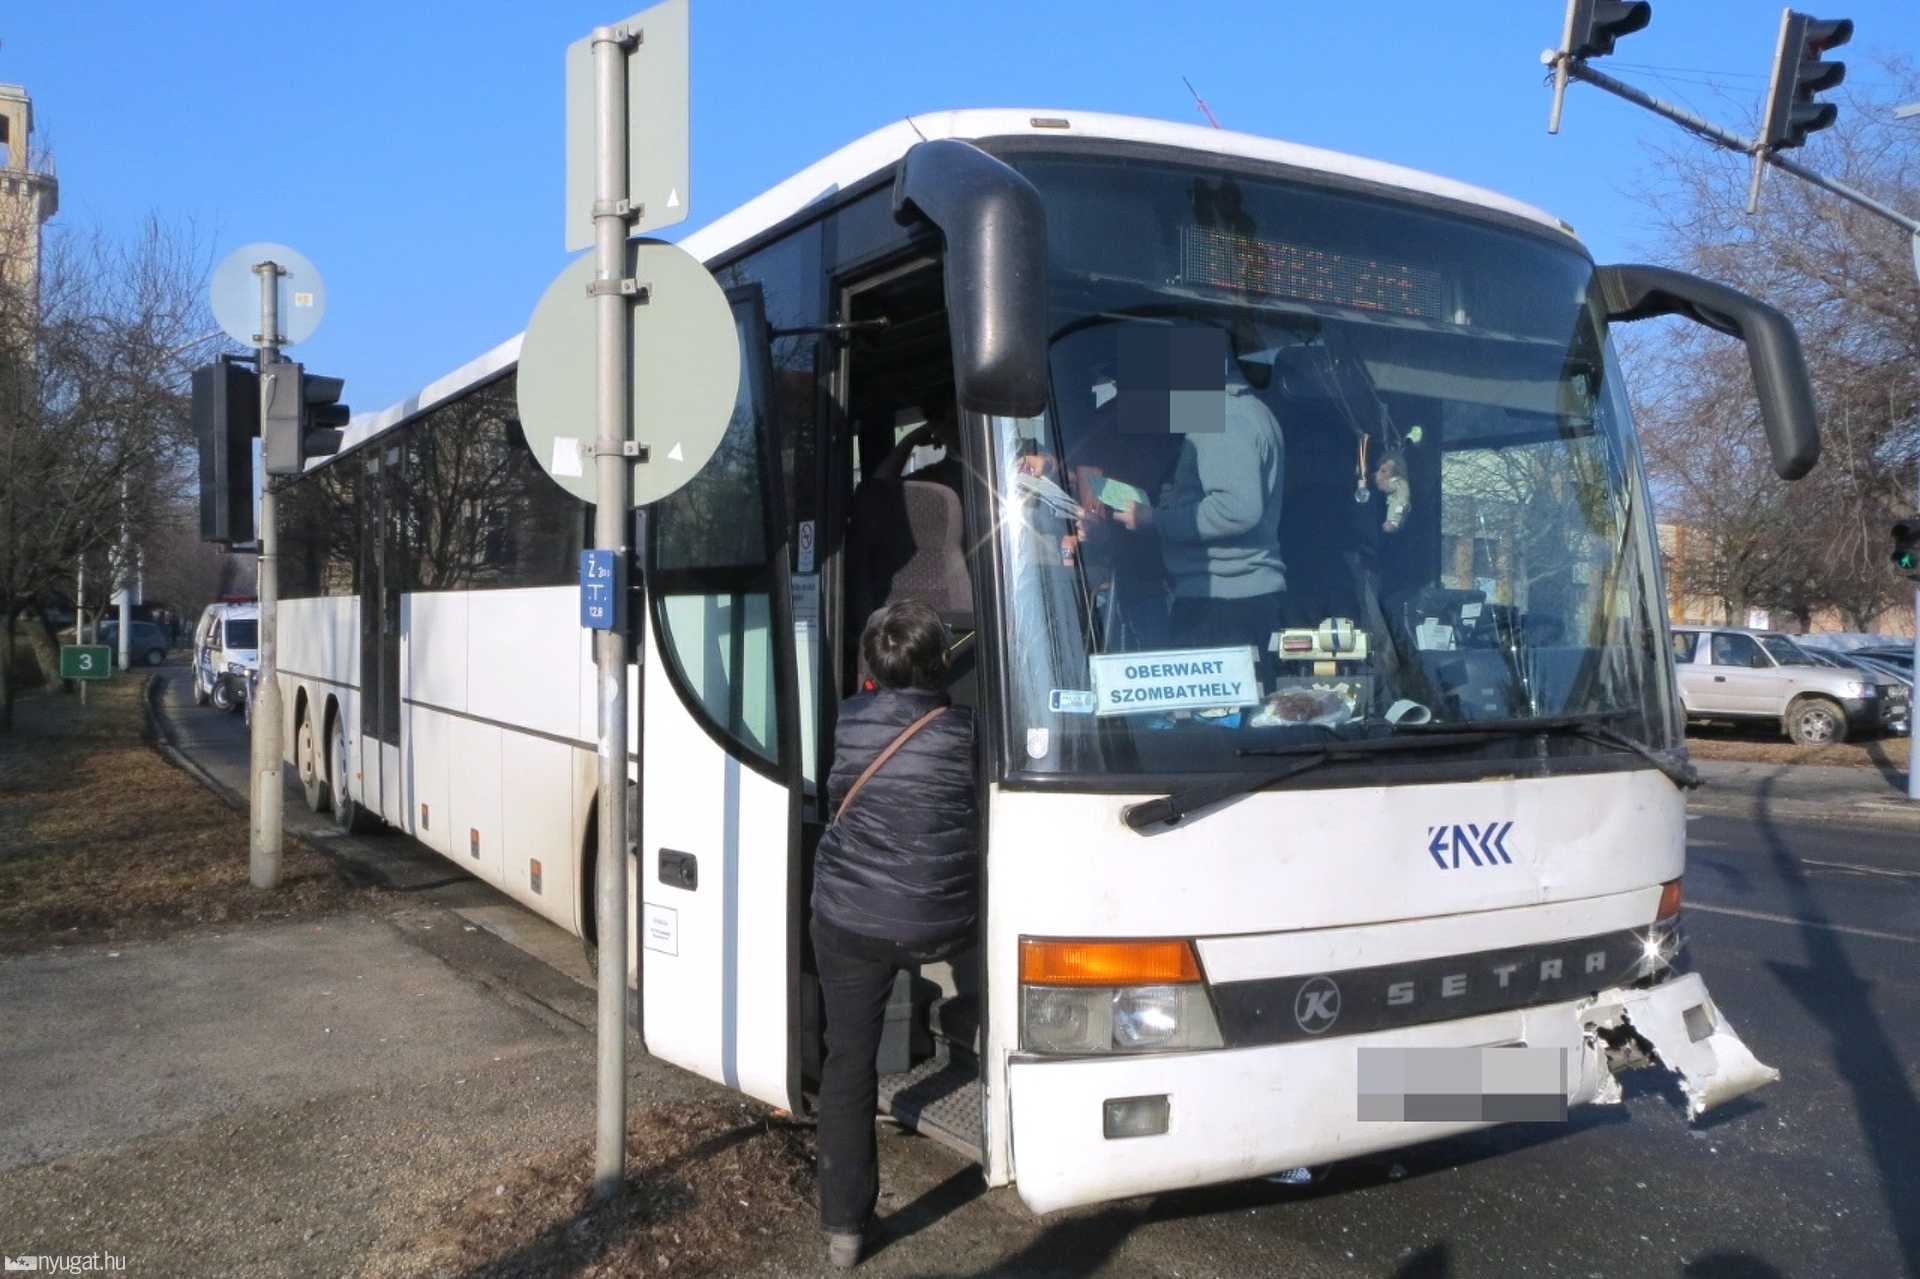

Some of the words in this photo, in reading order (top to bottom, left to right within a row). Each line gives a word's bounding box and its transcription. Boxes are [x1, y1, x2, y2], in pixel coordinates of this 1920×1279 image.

[79, 653, 93, 670] 3
[1124, 660, 1224, 680] OBERWART
[1110, 681, 1243, 704] SZOMBATHELY
[1387, 951, 1606, 1006] SETRA
